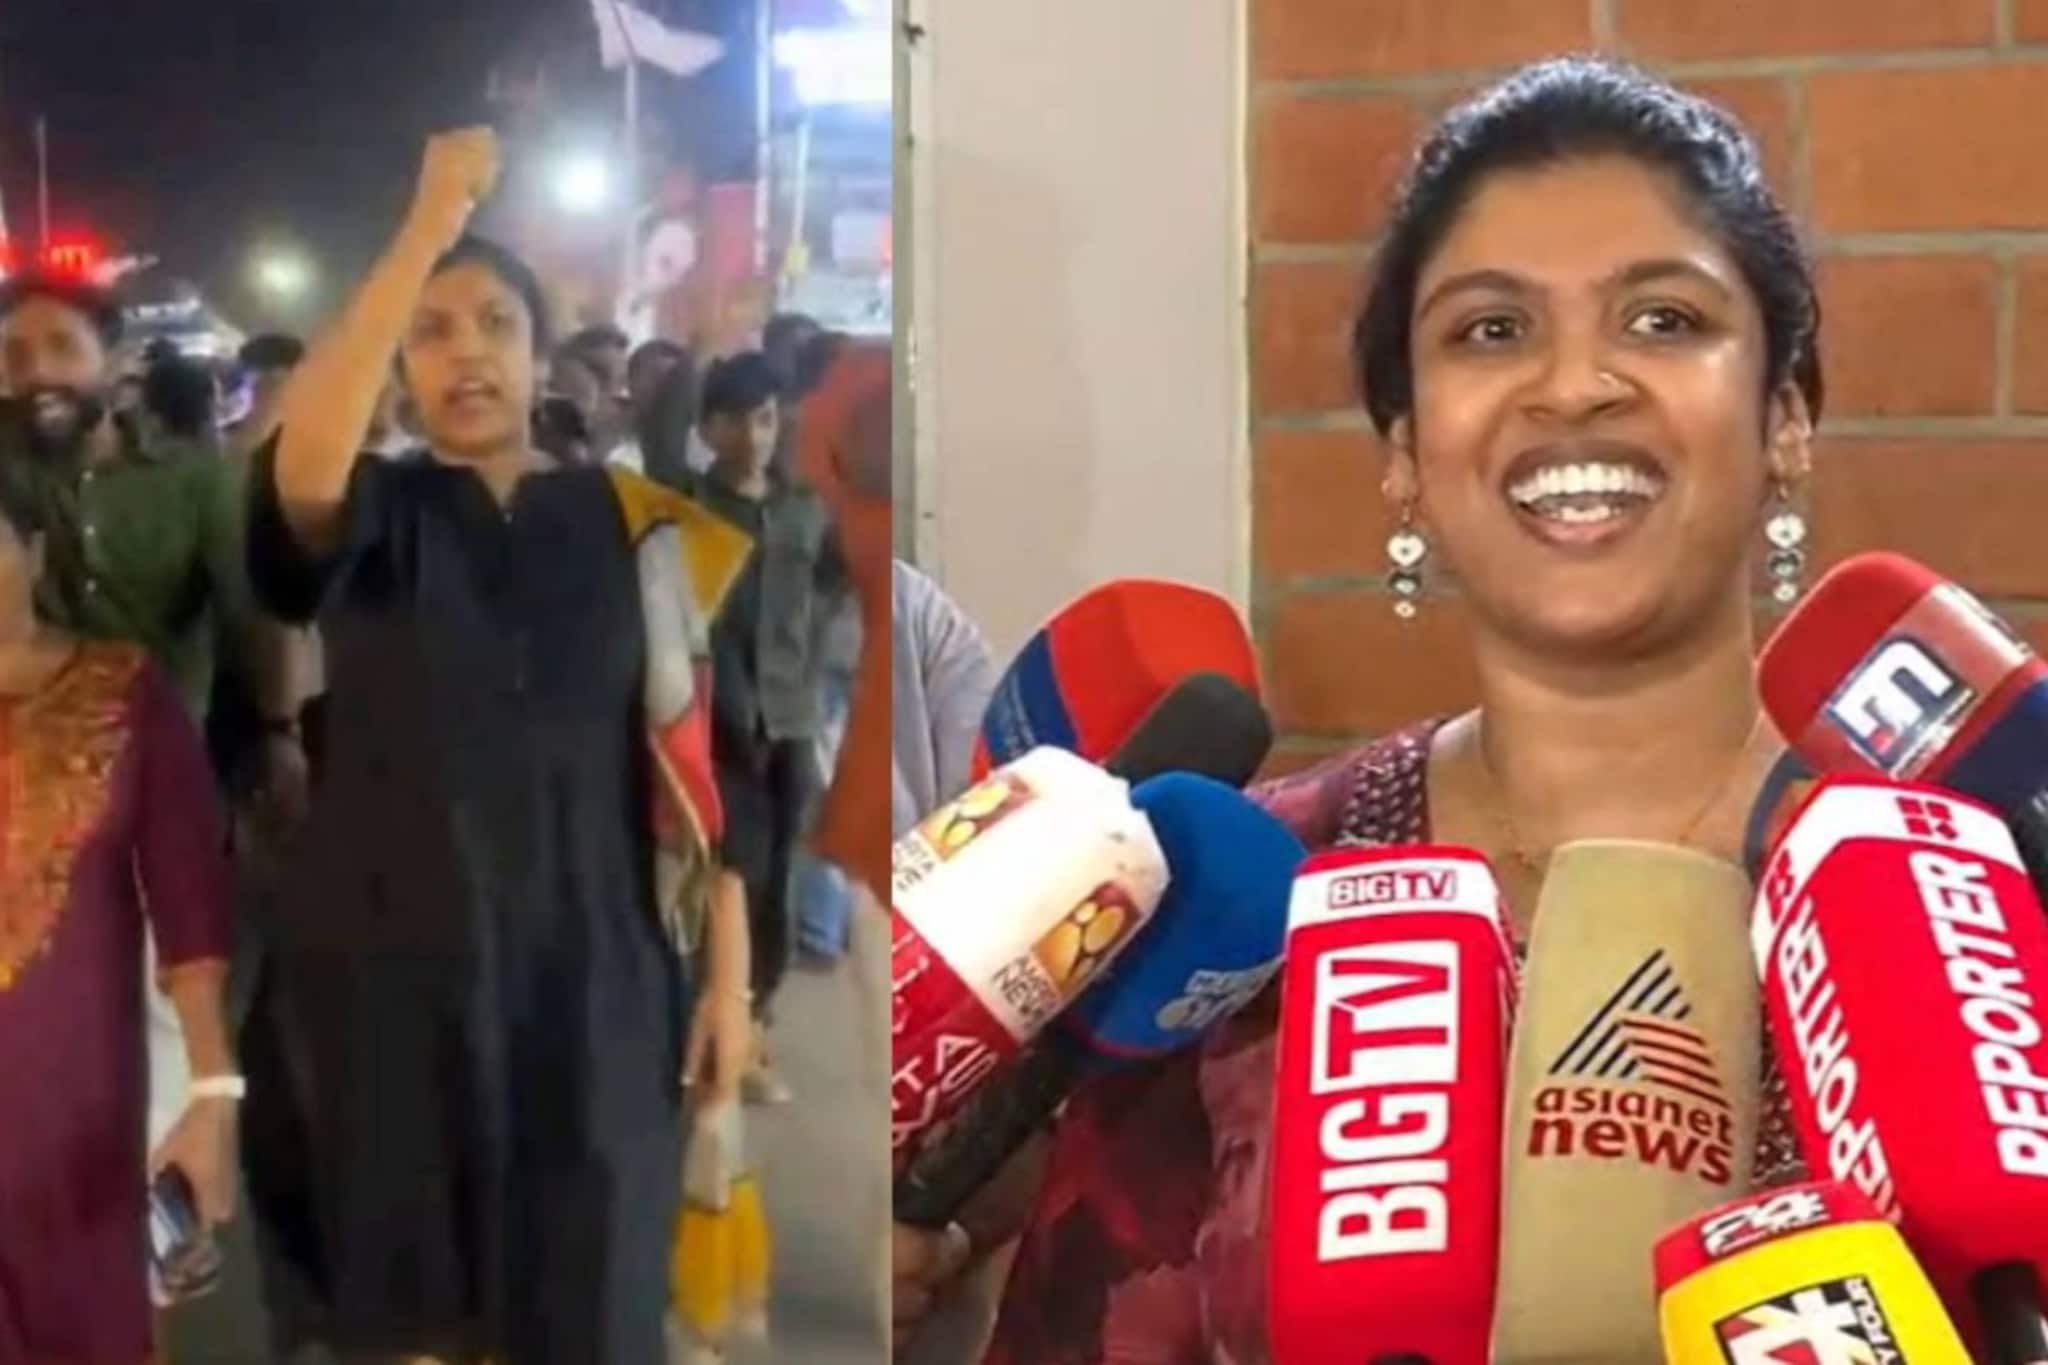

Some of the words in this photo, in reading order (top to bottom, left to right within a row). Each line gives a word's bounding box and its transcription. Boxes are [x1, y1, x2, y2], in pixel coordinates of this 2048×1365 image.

[1909, 851, 2048, 1176] REPORTER
[1527, 1113, 1734, 1187] news
[1535, 1084, 1735, 1147] asianet
